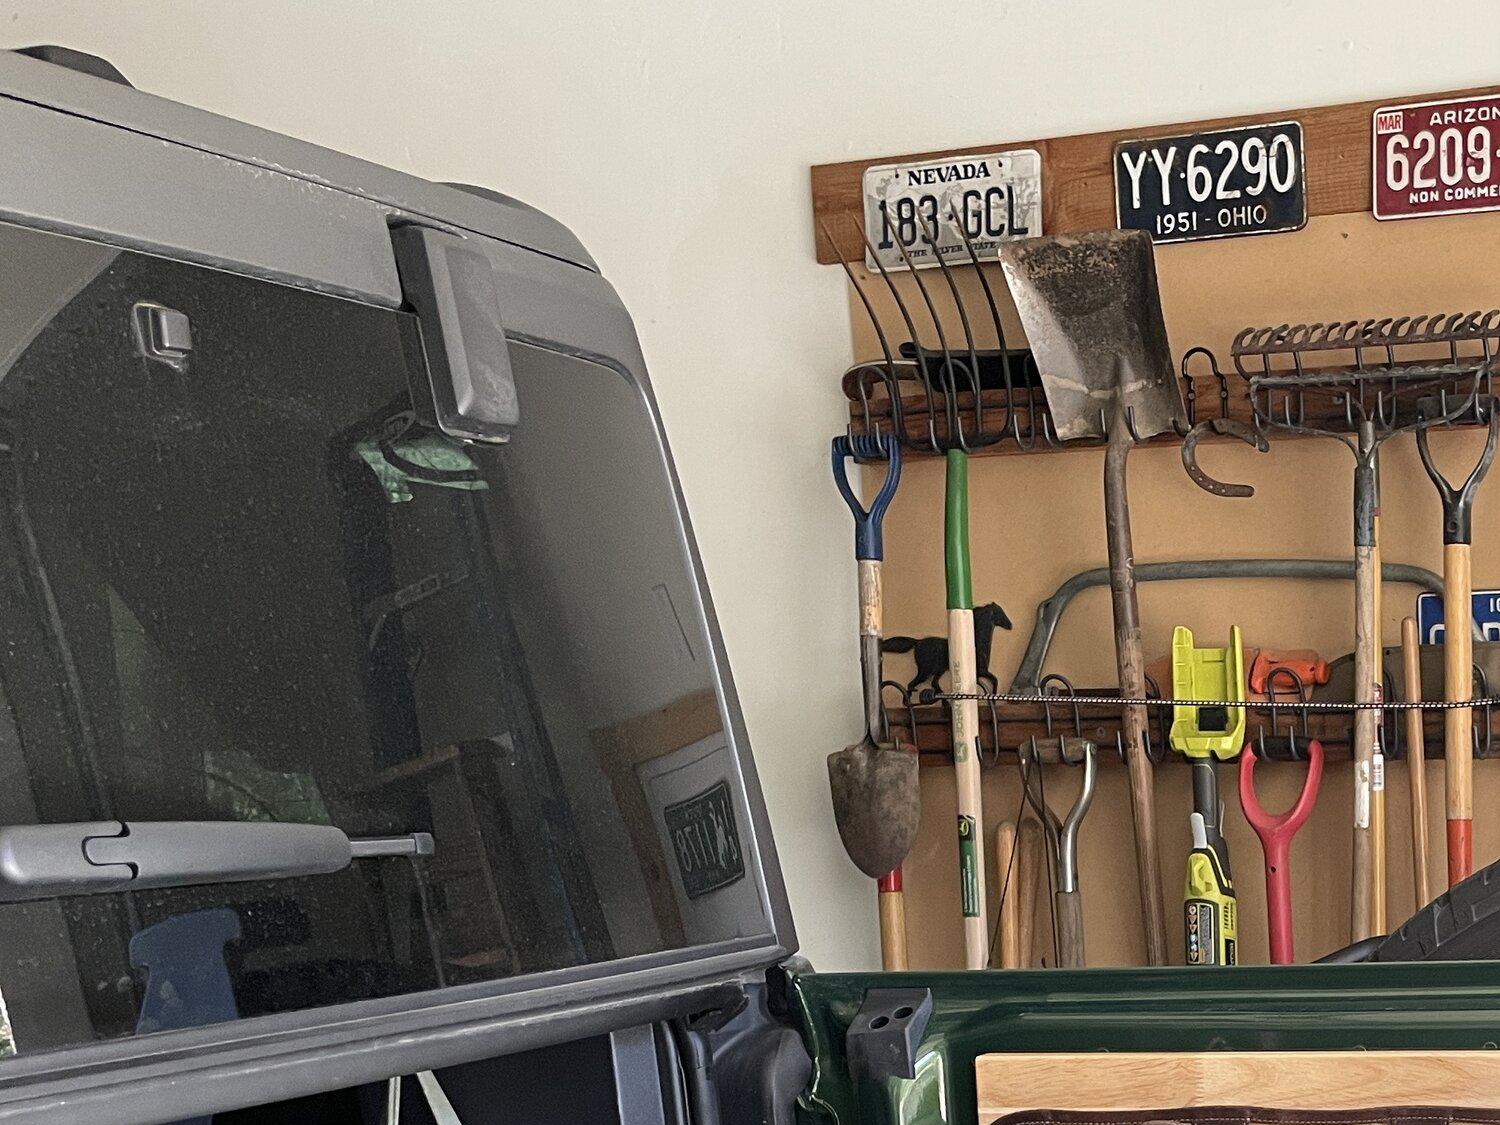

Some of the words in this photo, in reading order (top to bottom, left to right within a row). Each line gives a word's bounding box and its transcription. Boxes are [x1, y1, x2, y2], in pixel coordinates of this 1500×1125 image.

[1378, 114, 1402, 131] MAR
[908, 161, 991, 186] NEVADA
[1409, 190, 1439, 204] NON
[1156, 211, 1198, 234] 1951
[1217, 204, 1267, 227] OHIO
[907, 249, 928, 258] THE
[969, 241, 997, 251] TATE
